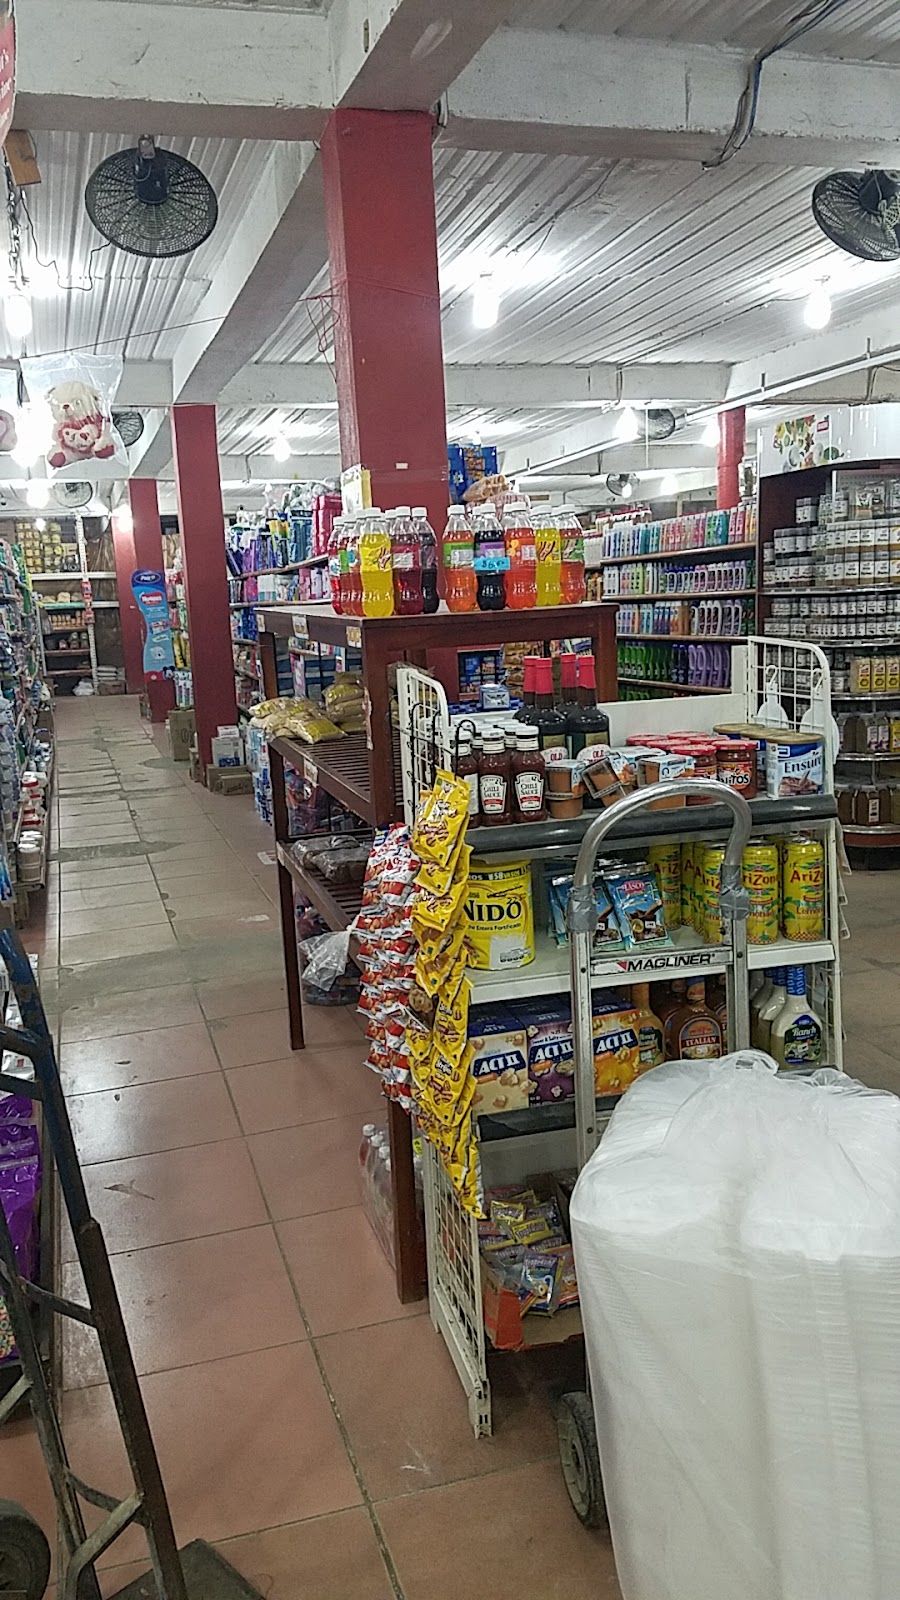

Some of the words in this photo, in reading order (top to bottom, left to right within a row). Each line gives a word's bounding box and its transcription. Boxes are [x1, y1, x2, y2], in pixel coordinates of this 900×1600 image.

[628, 953, 712, 972] MAGLINER
[685, 1036, 717, 1047] ITALIAN
[792, 1026, 817, 1037] Ranch
[534, 1044, 560, 1062] ACT
[560, 1041, 574, 1055] II
[596, 1034, 620, 1054] ACT
[619, 1031, 634, 1045] II
[478, 1057, 508, 1076] ACT
[506, 1053, 521, 1066] II
